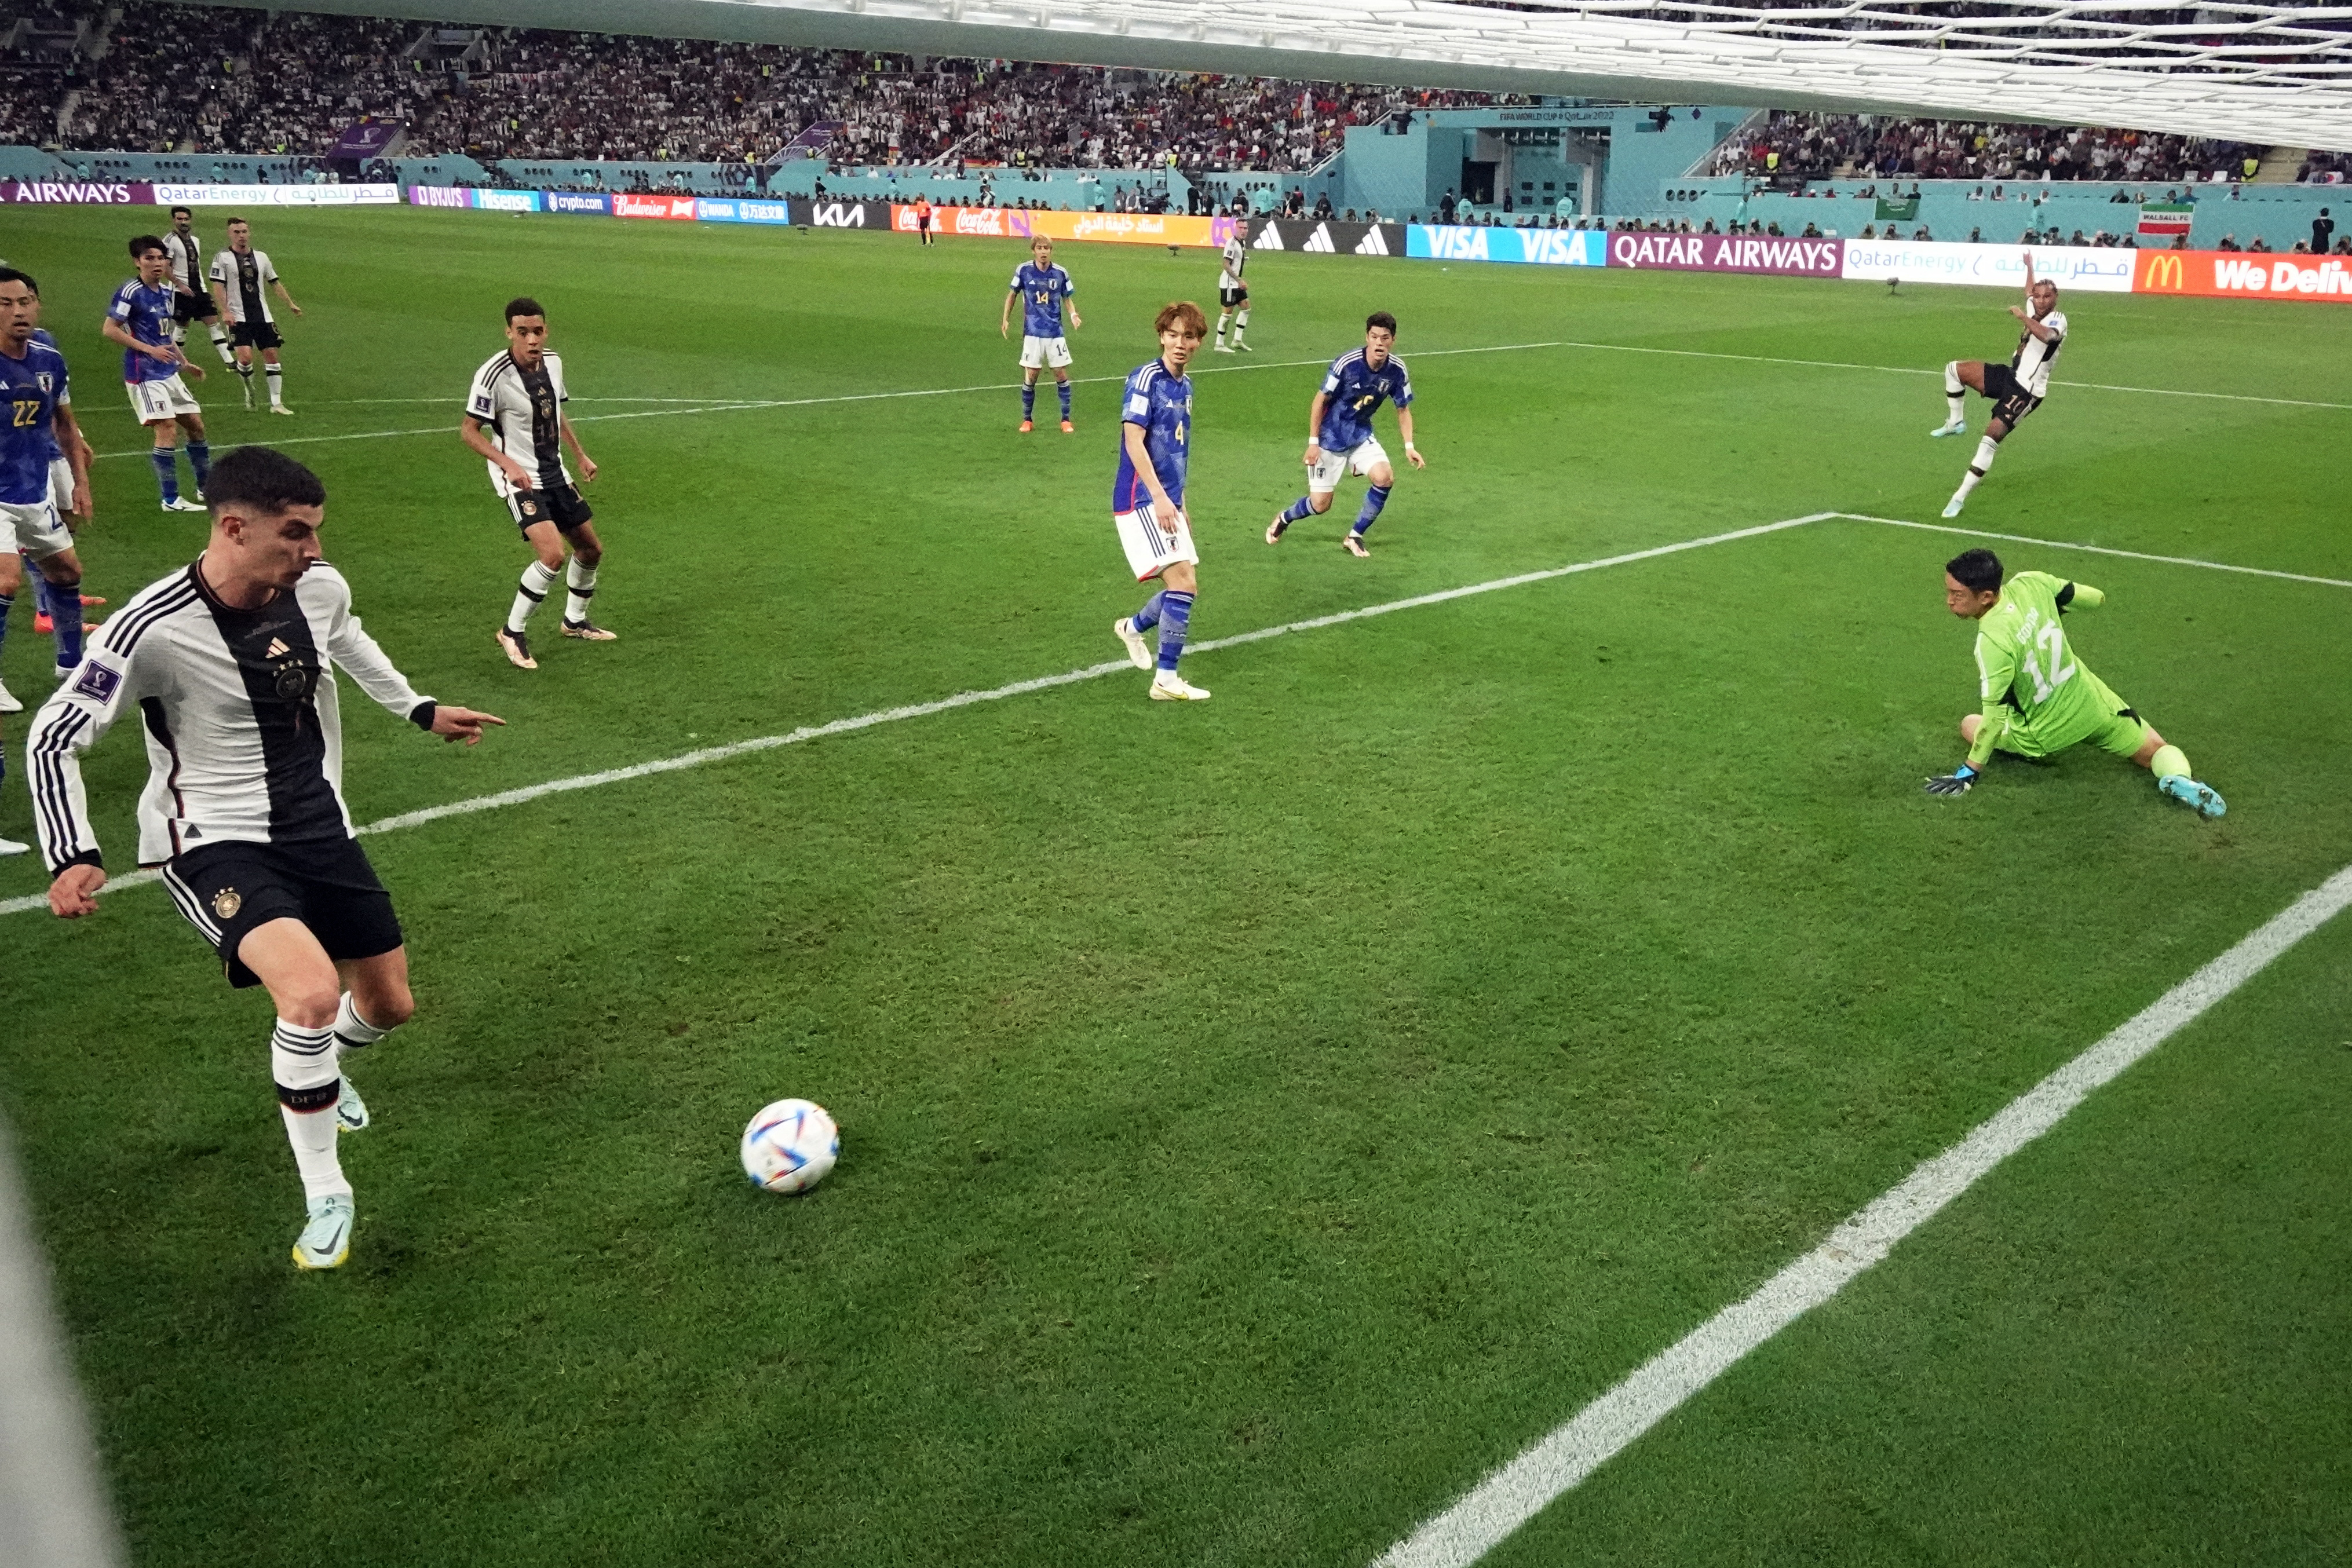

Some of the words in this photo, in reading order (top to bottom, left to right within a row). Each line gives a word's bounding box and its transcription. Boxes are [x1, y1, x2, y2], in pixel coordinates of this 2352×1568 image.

[1515, 112, 1542, 120] WORLD
[1543, 112, 1558, 120] CUP
[1593, 111, 1615, 120] 2022
[16, 182, 131, 203] AIRWAYS
[159, 187, 266, 203] QatarEnergy
[352, 186, 394, 202] قطر
[429, 187, 463, 207] BYJU'S
[478, 188, 532, 211] Hisense
[558, 196, 603, 210] crypto.com
[613, 195, 666, 215] Budweiser
[707, 203, 735, 217] WANDA
[956, 207, 1002, 235] Coca-Cola
[1423, 225, 1489, 260] VISA
[1517, 228, 1588, 265] VISA
[1615, 236, 1704, 268] QATAR
[1714, 239, 1836, 271] AIRWAYS
[1849, 248, 1966, 273] QatarEnergy
[2069, 257, 2128, 280] قطر
[2215, 259, 2267, 290] We
[1035, 290, 1049, 305] 14
[13, 400, 41, 427] 22
[1175, 421, 1184, 445] 4
[2021, 617, 2076, 705] 12
